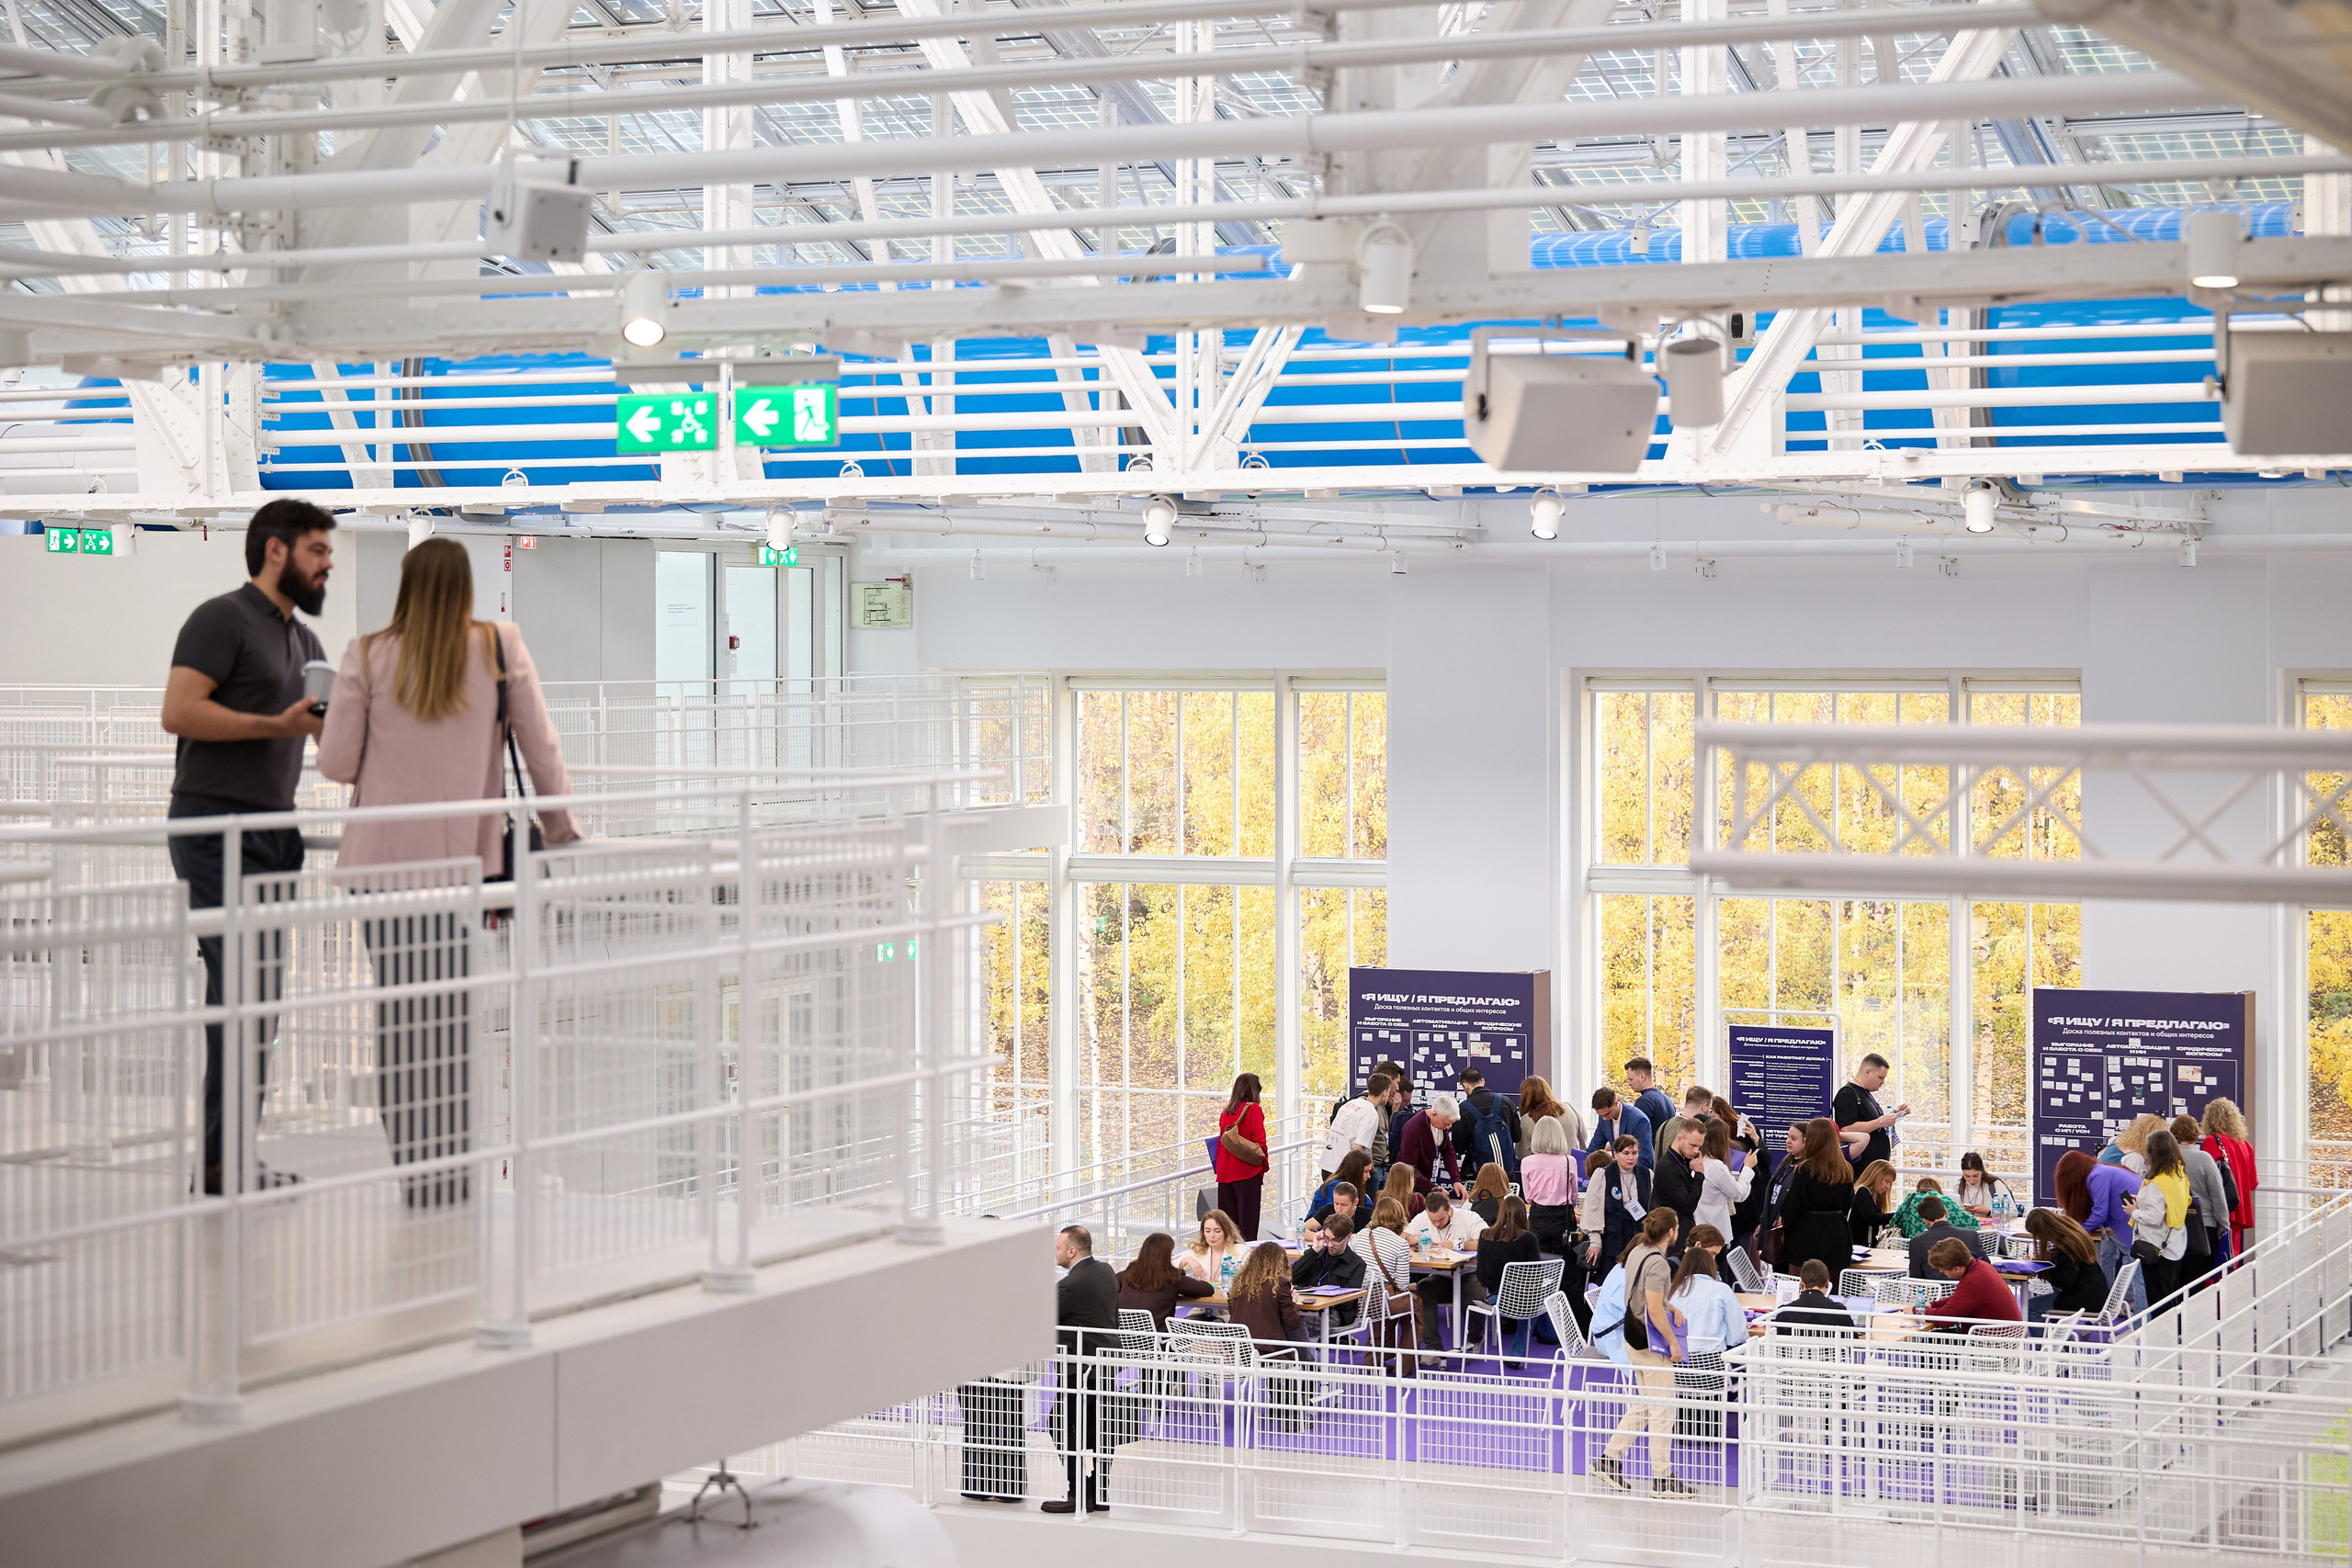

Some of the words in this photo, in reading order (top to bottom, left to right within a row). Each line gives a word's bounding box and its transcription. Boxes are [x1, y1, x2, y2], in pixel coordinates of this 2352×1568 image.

[1361, 993, 1376, 1001] «Я
[1377, 993, 1410, 1003] ИЩУ
[1411, 994, 1416, 1003] /
[1428, 995, 1520, 1006] ПРЕДЛАГАЮ»
[2047, 1016, 2064, 1025] «Я
[2066, 1017, 2103, 1027] ИЩУ
[2104, 1017, 2110, 1027] /
[2111, 1018, 2123, 1027] Я
[2125, 1019, 2230, 1030] ПРЕДЛАГАЮ»
